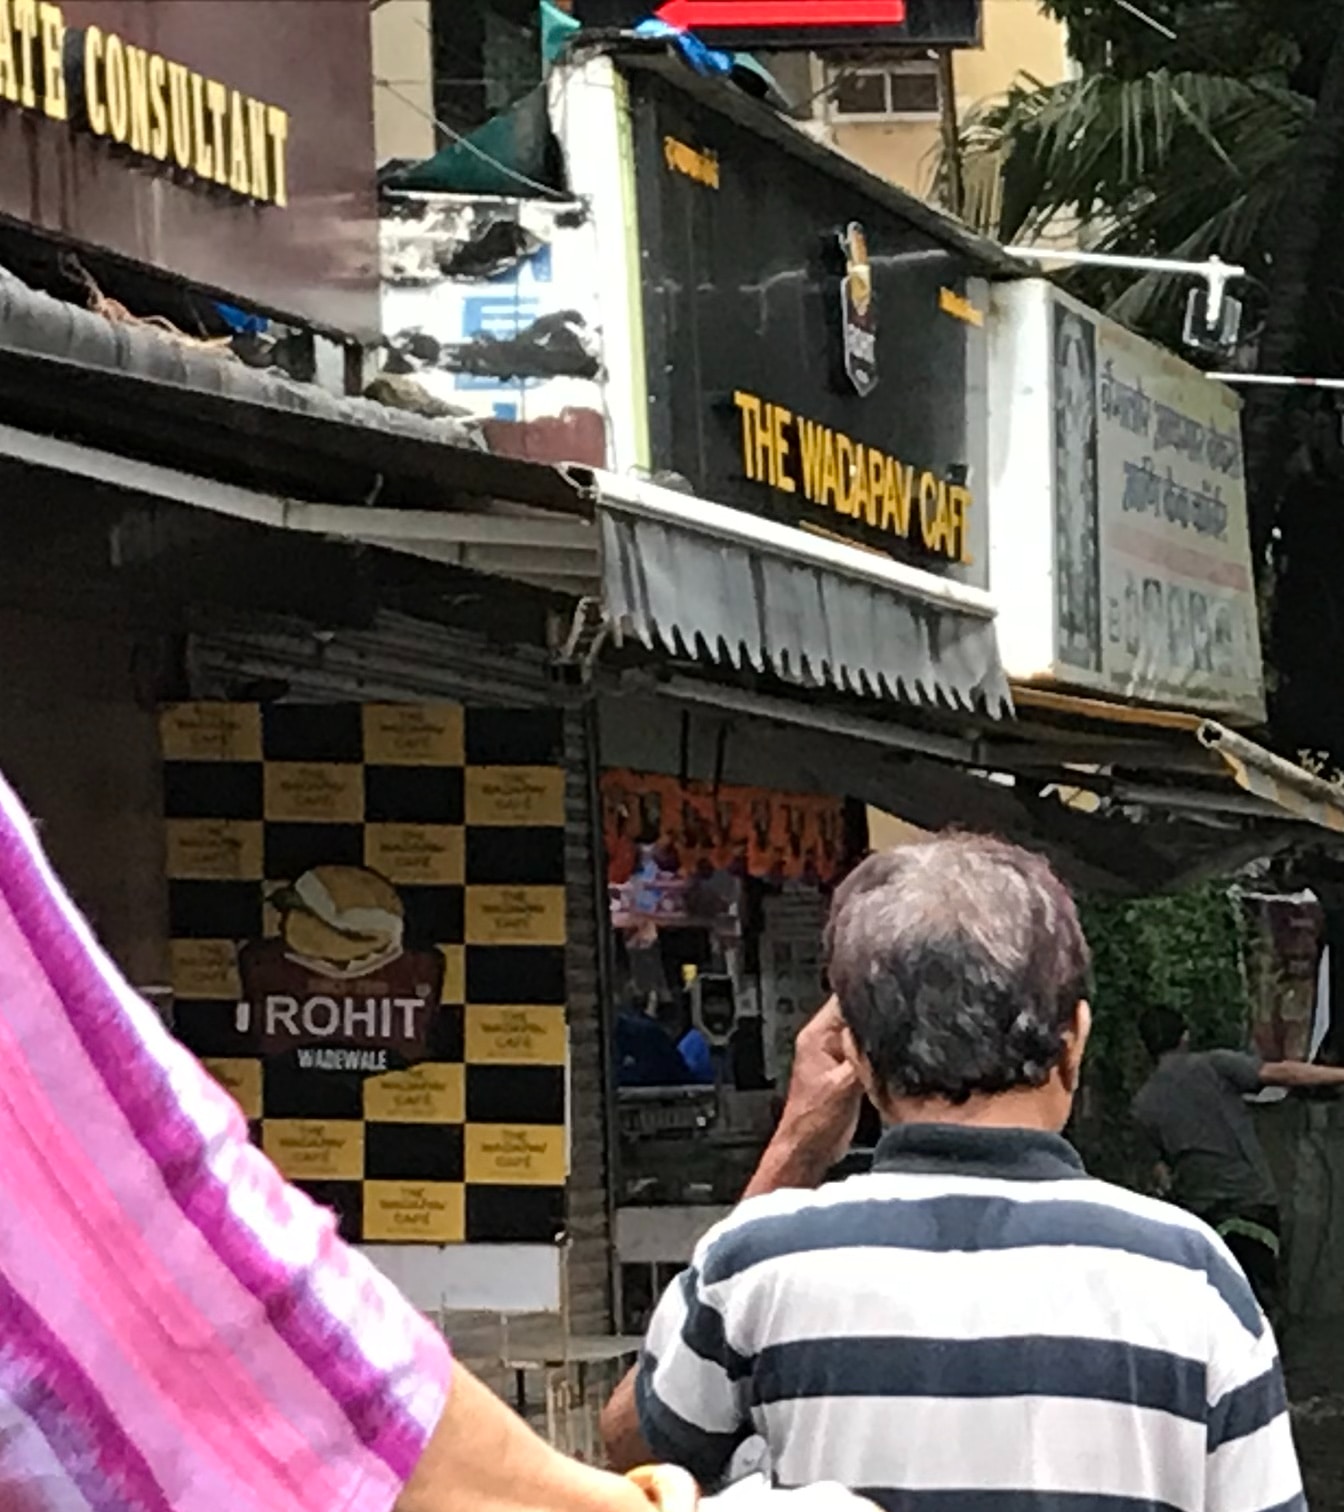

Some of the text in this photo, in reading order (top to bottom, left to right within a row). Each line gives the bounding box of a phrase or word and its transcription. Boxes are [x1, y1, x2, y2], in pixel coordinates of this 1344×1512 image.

[85, 25, 288, 208] CONSULTANT
[734, 390, 796, 493] THE
[797, 415, 914, 538] WADAPAV
[266, 996, 425, 1038] ROHIT
